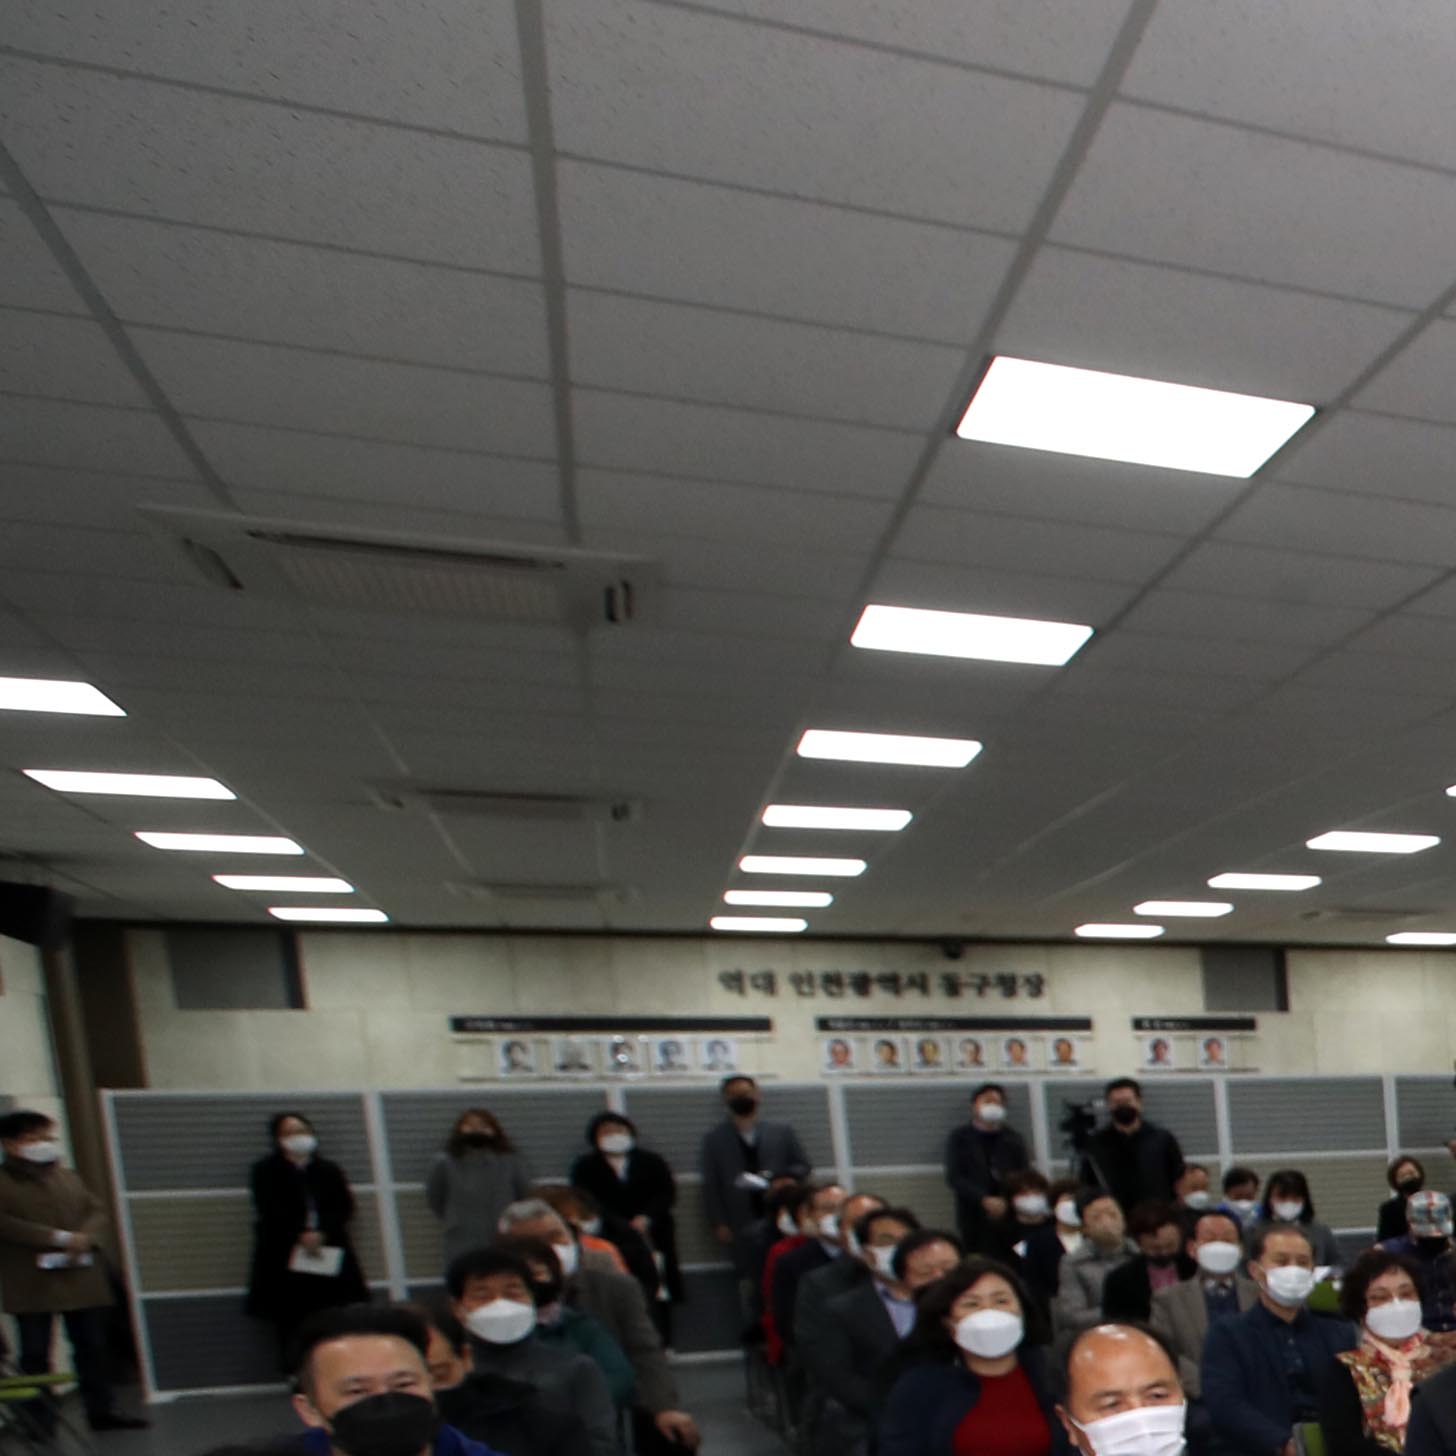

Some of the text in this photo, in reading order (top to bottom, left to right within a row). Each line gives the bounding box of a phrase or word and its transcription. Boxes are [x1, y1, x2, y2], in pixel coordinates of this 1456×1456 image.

[717, 968, 1045, 998] 역대 인천광역시 동구청장
